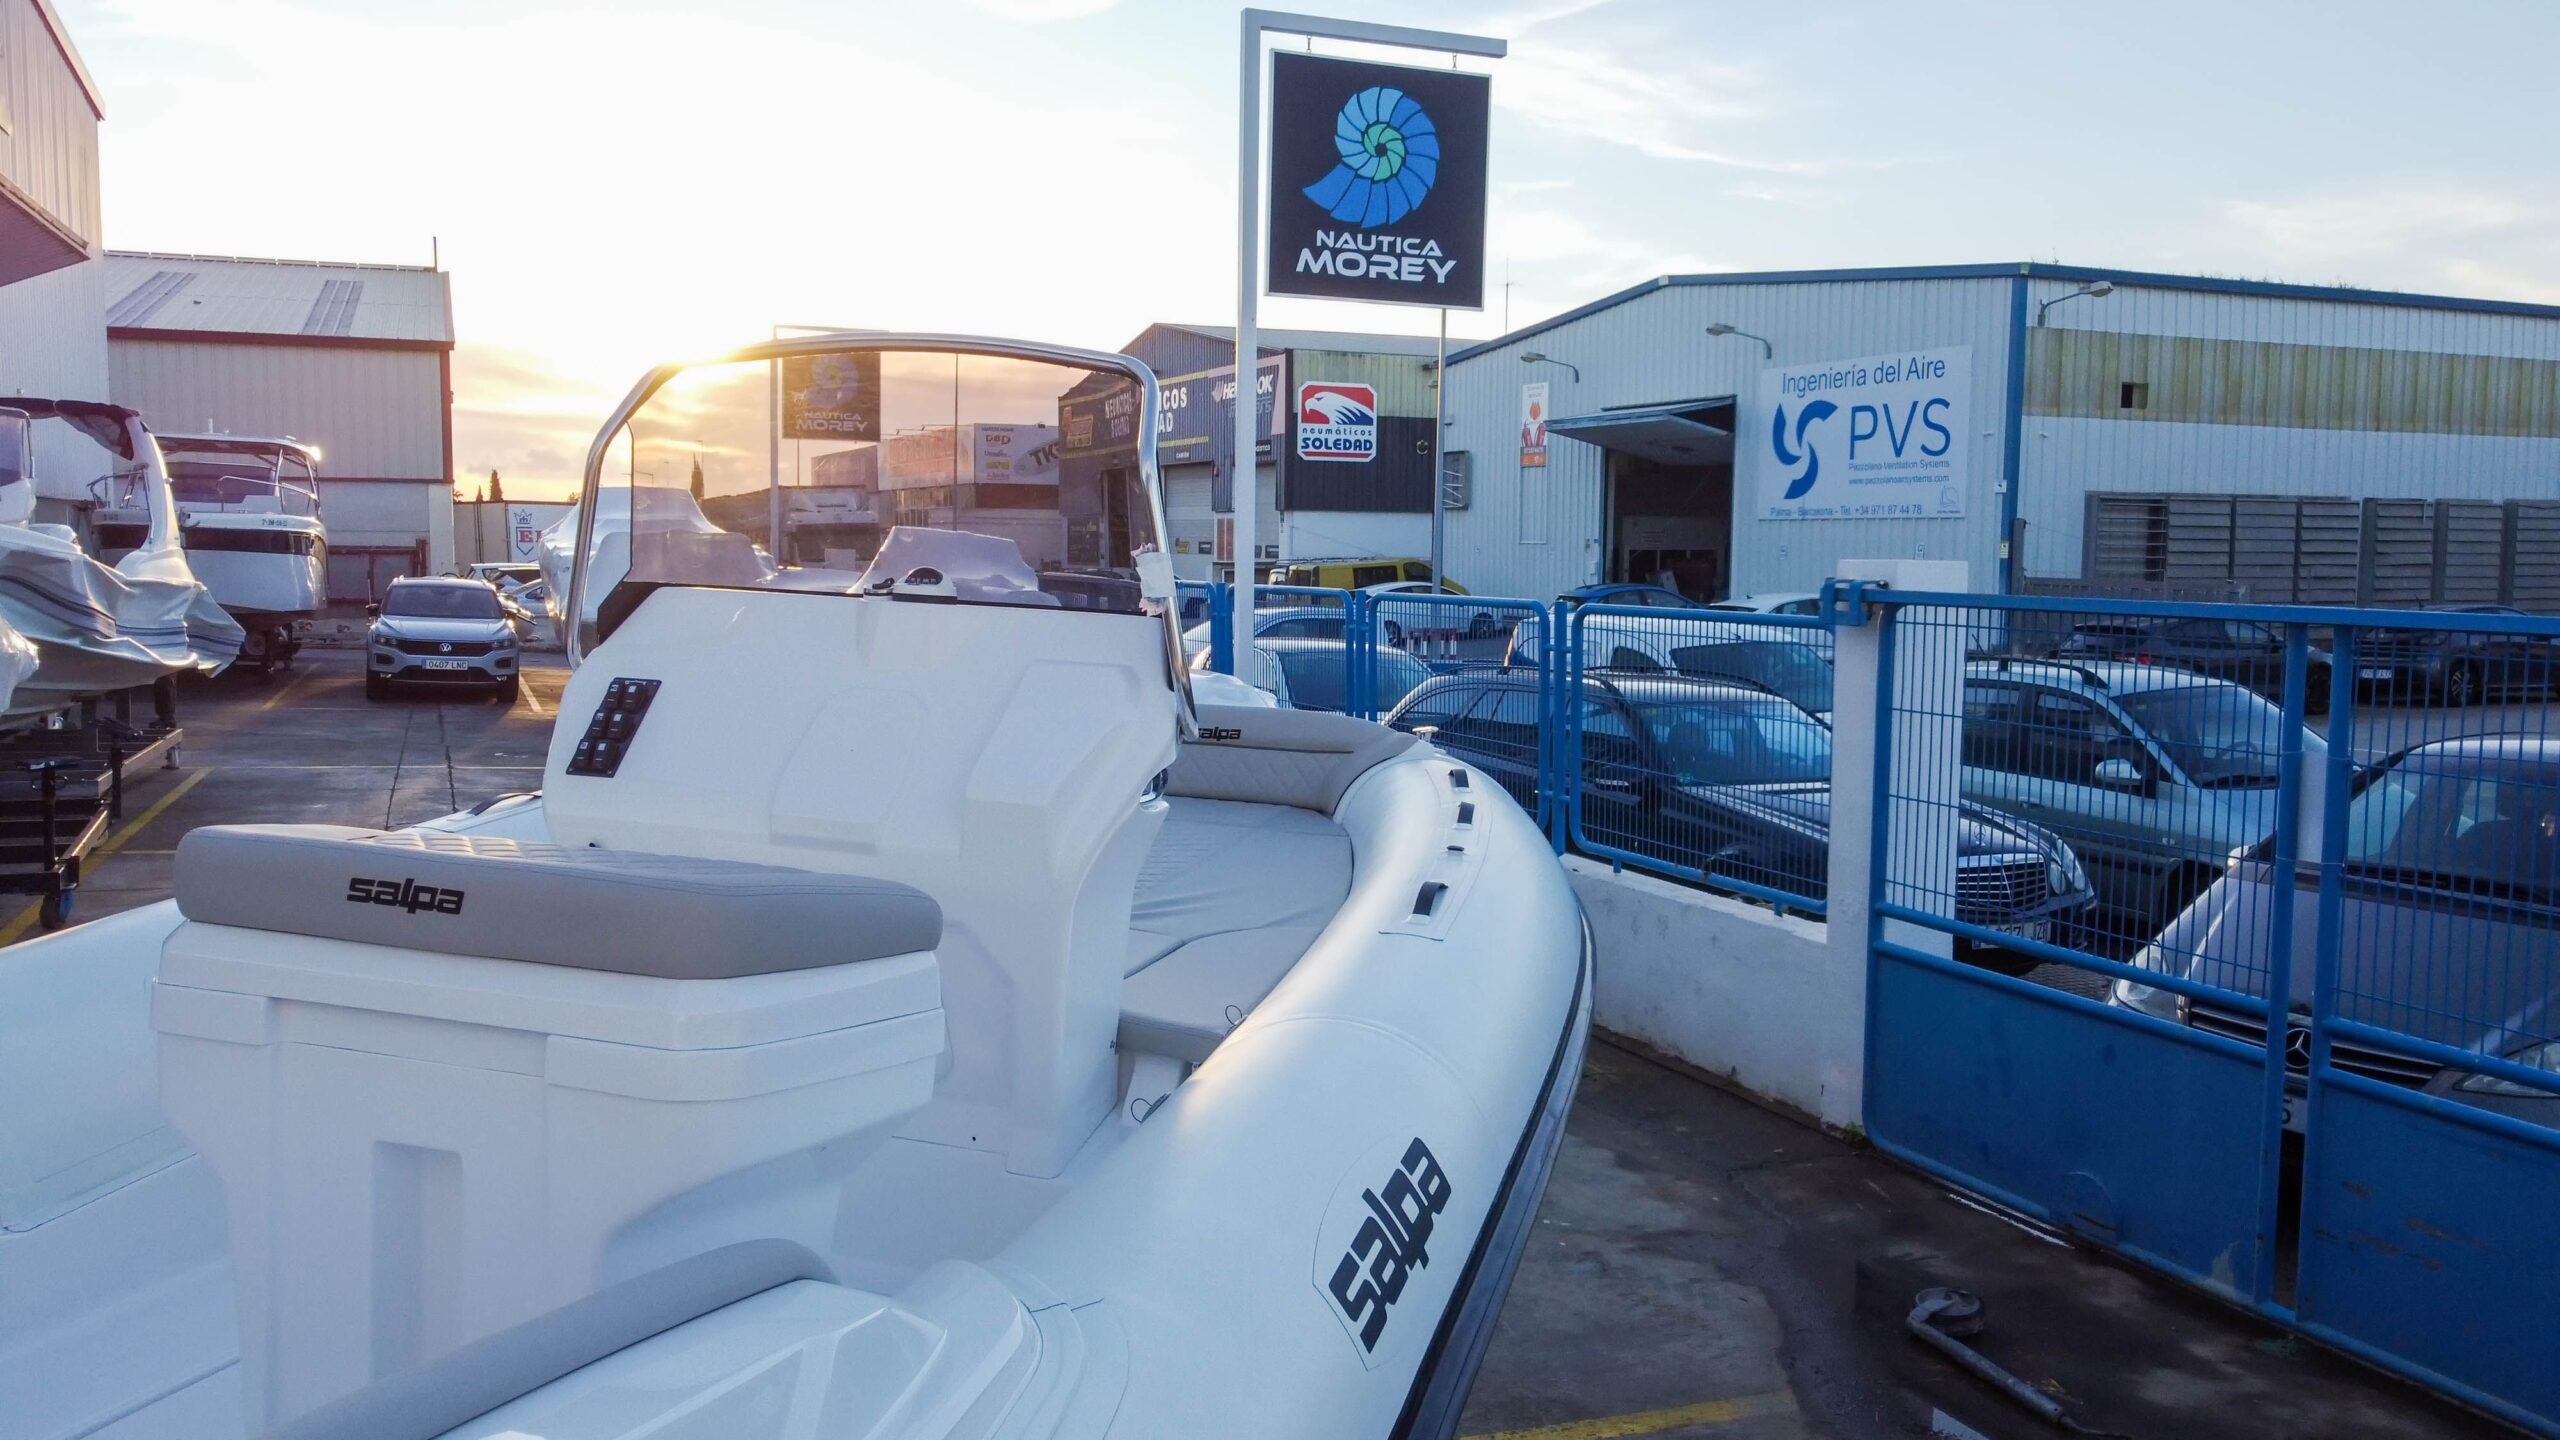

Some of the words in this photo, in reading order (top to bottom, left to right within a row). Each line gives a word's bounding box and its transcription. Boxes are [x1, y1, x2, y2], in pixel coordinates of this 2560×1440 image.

[1316, 229, 1443, 256] NAUTICA
[1295, 247, 1457, 283] MOREY
[1782, 364, 1867, 398] Ingeniería
[1873, 358, 1901, 385] del
[1906, 356, 1946, 381] Aire
[795, 420, 868, 432] MOREY
[1302, 427, 1373, 437] neumáticos
[1849, 397, 1951, 460] PVS
[1301, 437, 1374, 452] SOLEDAD
[1920, 459, 1950, 470] Systems
[1870, 504, 1885, 516] 971
[1887, 504, 1898, 516] 87
[1912, 504, 1922, 515] 78
[1198, 726, 1242, 742] alpa
[346, 877, 465, 915] salpa
[1328, 1136, 1452, 1355] salpa
